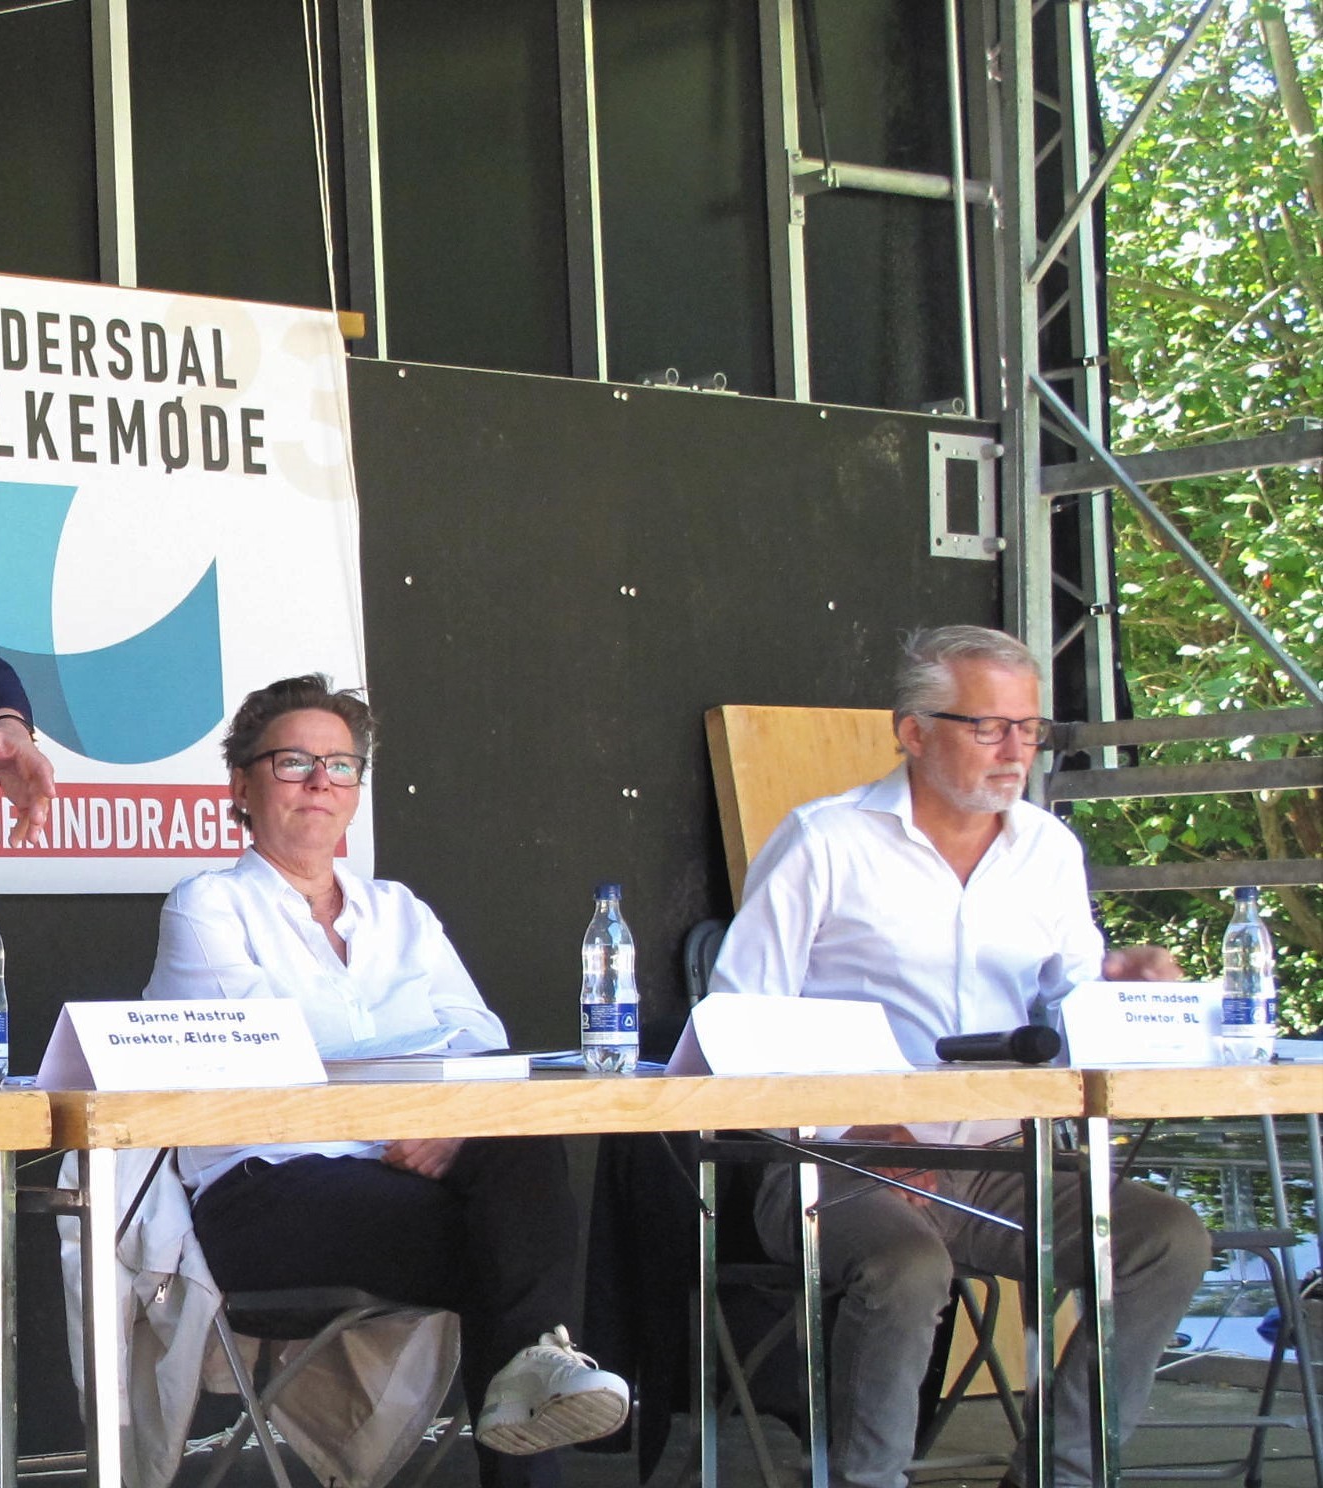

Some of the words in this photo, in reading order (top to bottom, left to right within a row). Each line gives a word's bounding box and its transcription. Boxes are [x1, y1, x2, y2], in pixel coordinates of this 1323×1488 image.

[1118, 991, 1147, 1003] Bent
[1151, 993, 1200, 1004] madsen
[127, 1011, 179, 1025] Bjarne
[183, 1010, 246, 1023] Hastrup
[1183, 1012, 1200, 1024] BL
[184, 1031, 228, 1044] Ældre
[231, 1030, 281, 1045] Sagen
